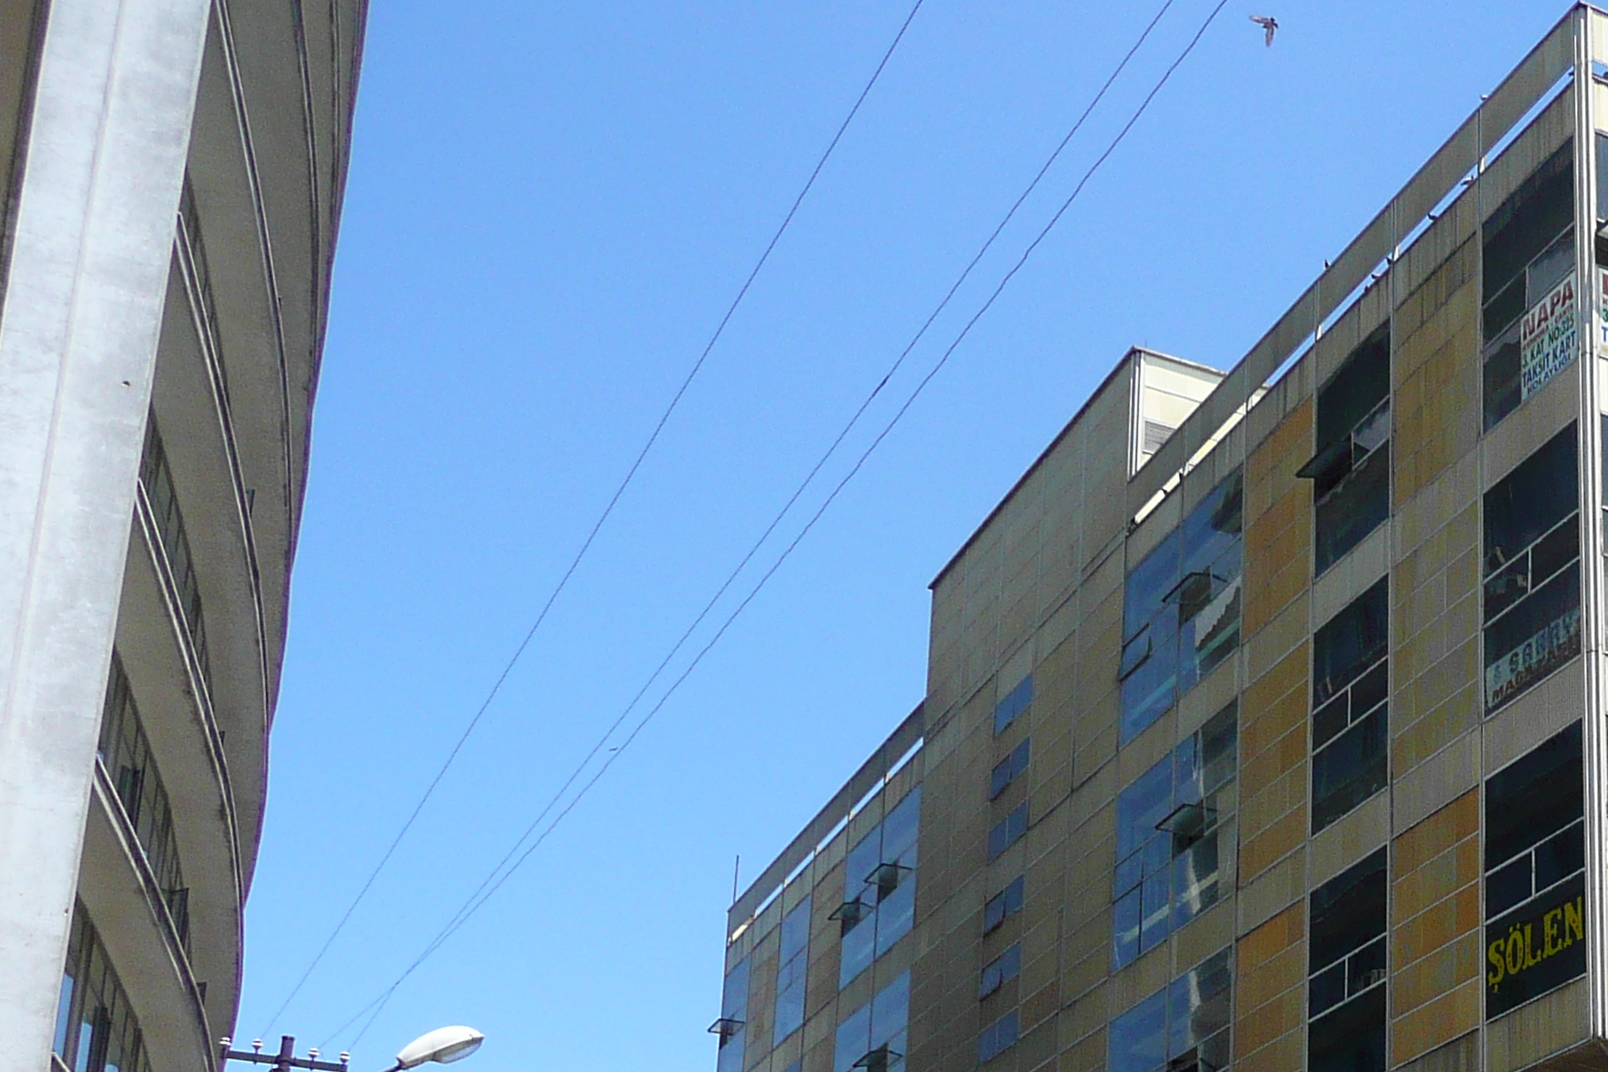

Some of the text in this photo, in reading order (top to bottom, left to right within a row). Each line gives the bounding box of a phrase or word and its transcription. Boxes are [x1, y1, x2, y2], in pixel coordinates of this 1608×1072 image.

[1523, 280, 1574, 341] NAPA
[1530, 339, 1544, 360] KAT
[1552, 330, 1576, 358] KART
[1488, 896, 1583, 993] ŞÖLEN
